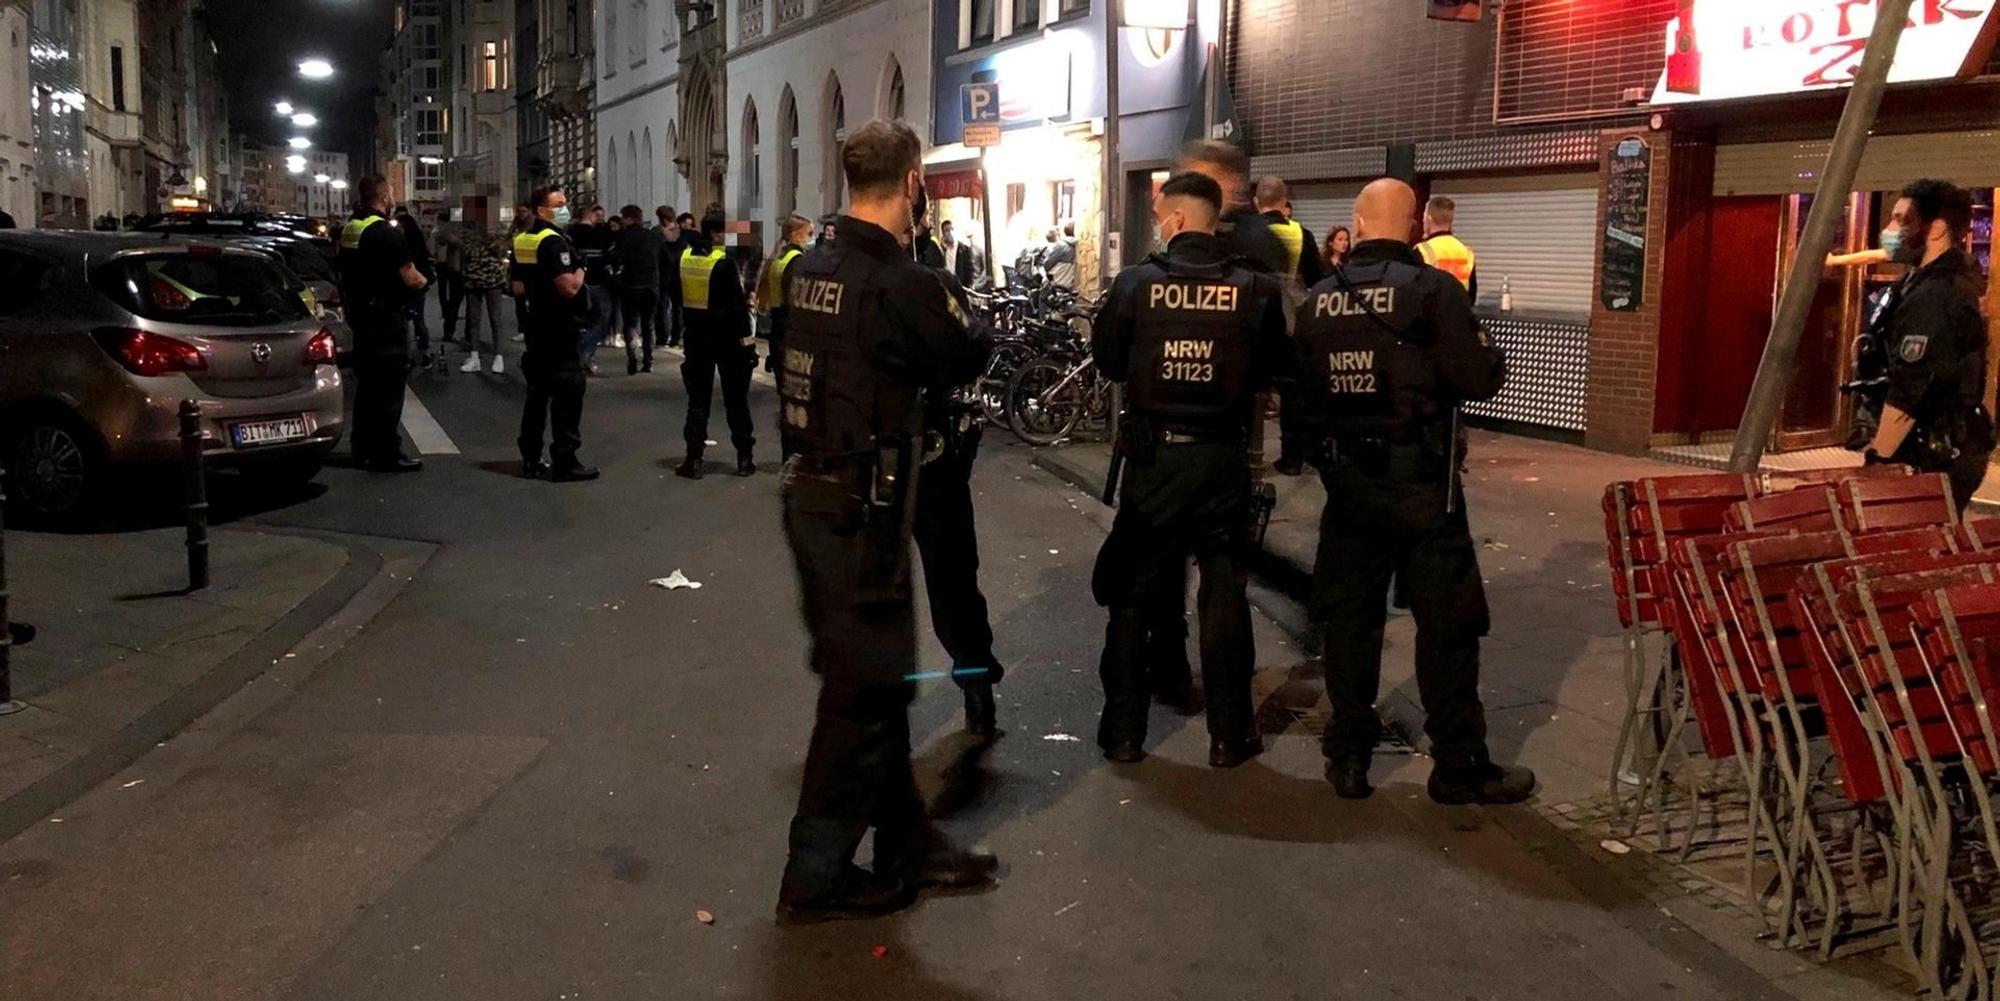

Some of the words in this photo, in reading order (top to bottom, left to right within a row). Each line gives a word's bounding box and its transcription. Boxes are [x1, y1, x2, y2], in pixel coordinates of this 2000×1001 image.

[970, 89, 990, 120] P
[1149, 283, 1238, 311] POLIZEI
[1164, 340, 1214, 359] NRW
[1329, 350, 1374, 371] NRW
[1162, 361, 1213, 382] 31123
[1330, 374, 1376, 393] 31122
[285, 419, 304, 436] 711
